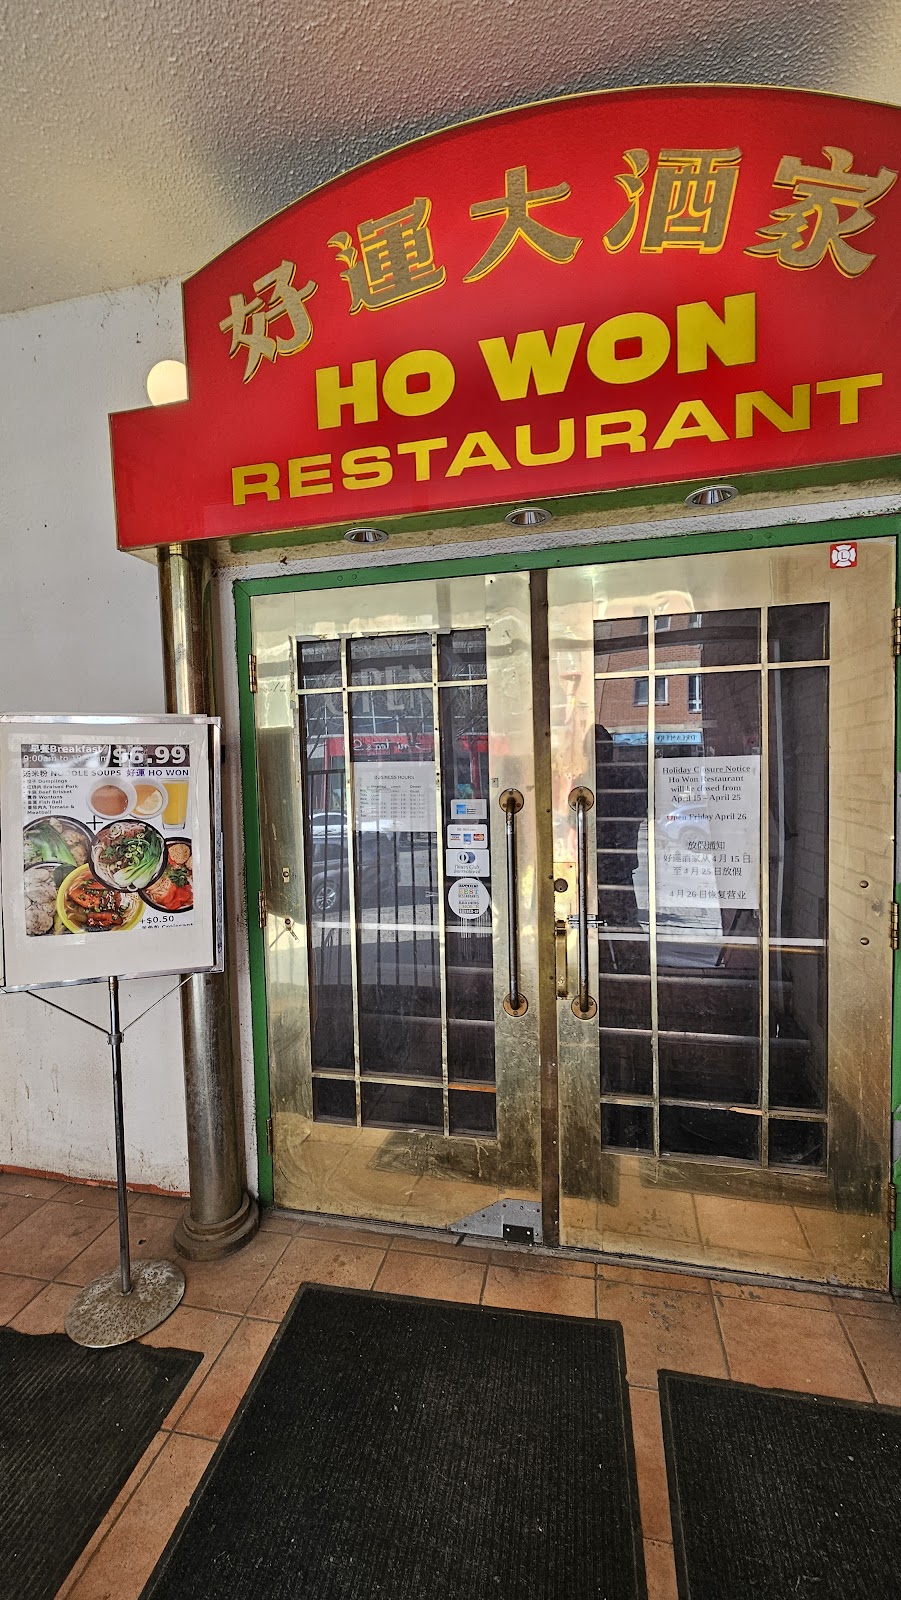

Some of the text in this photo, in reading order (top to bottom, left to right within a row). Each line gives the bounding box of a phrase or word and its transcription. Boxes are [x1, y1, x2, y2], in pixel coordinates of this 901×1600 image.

[218, 146, 898, 385] 好運大酒家
[314, 291, 757, 430] HO WON
[230, 373, 884, 507] RESTAURANT
[112, 745, 186, 766] $6.99
[709, 794, 730, 802] April
[714, 813, 735, 821] April
[687, 841, 726, 850] 放假通知
